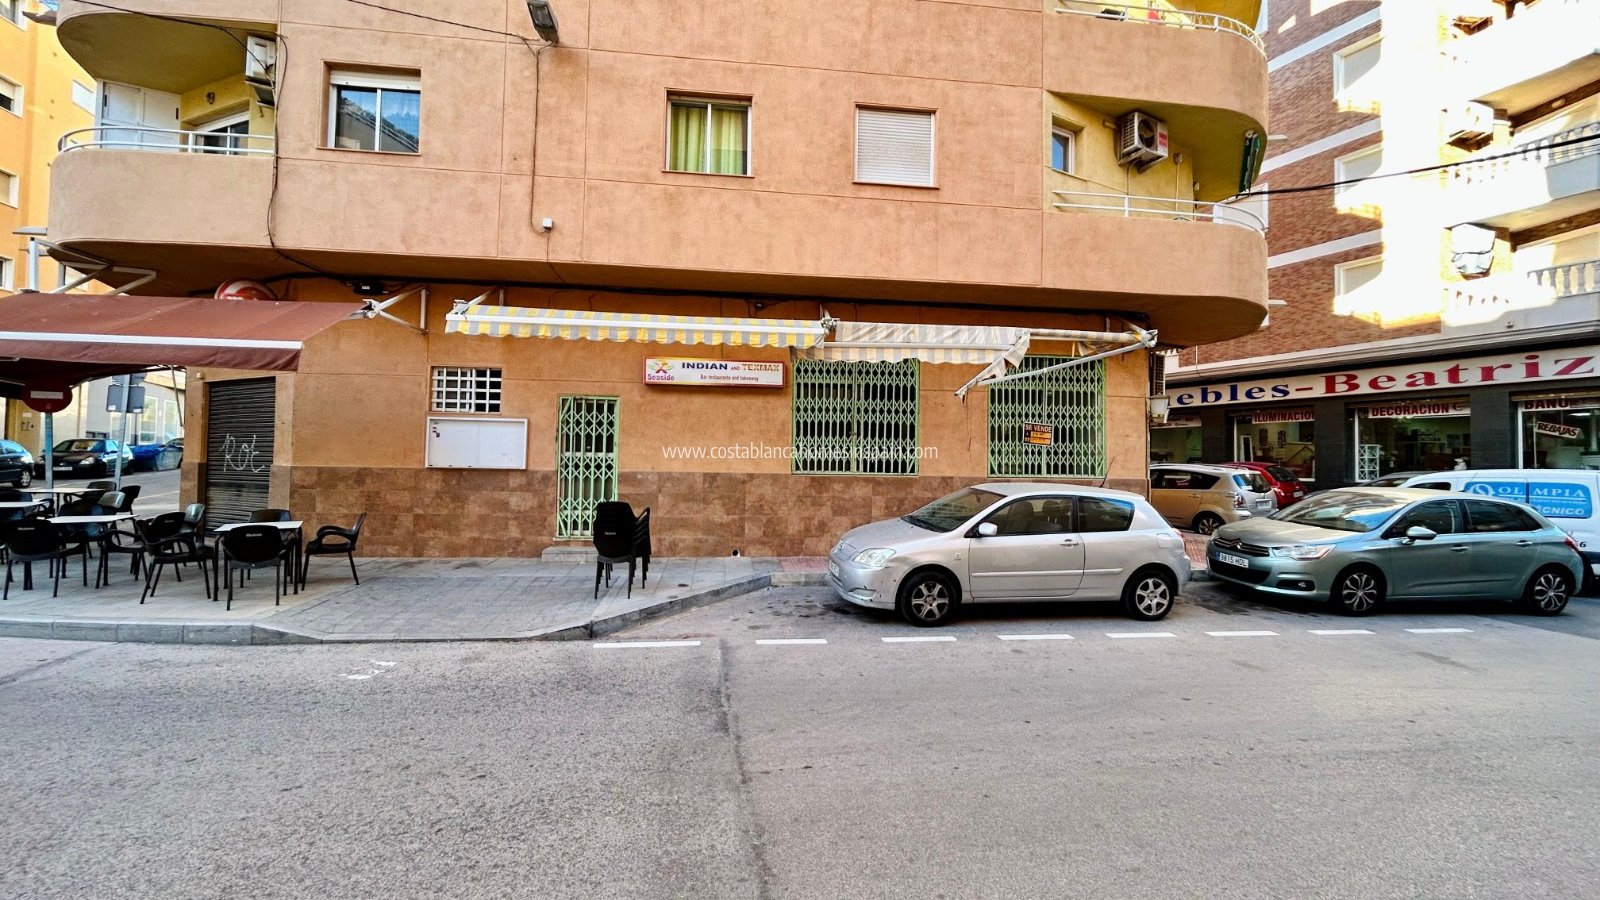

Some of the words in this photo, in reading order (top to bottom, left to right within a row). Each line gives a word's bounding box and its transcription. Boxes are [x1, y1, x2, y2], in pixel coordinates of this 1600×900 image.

[681, 362, 728, 370] INDIAN
[742, 363, 780, 372] TEXMAX
[647, 373, 675, 381] Seaside
[1033, 425, 1052, 433] VENDE
[1537, 422, 1577, 437] REBAJAS
